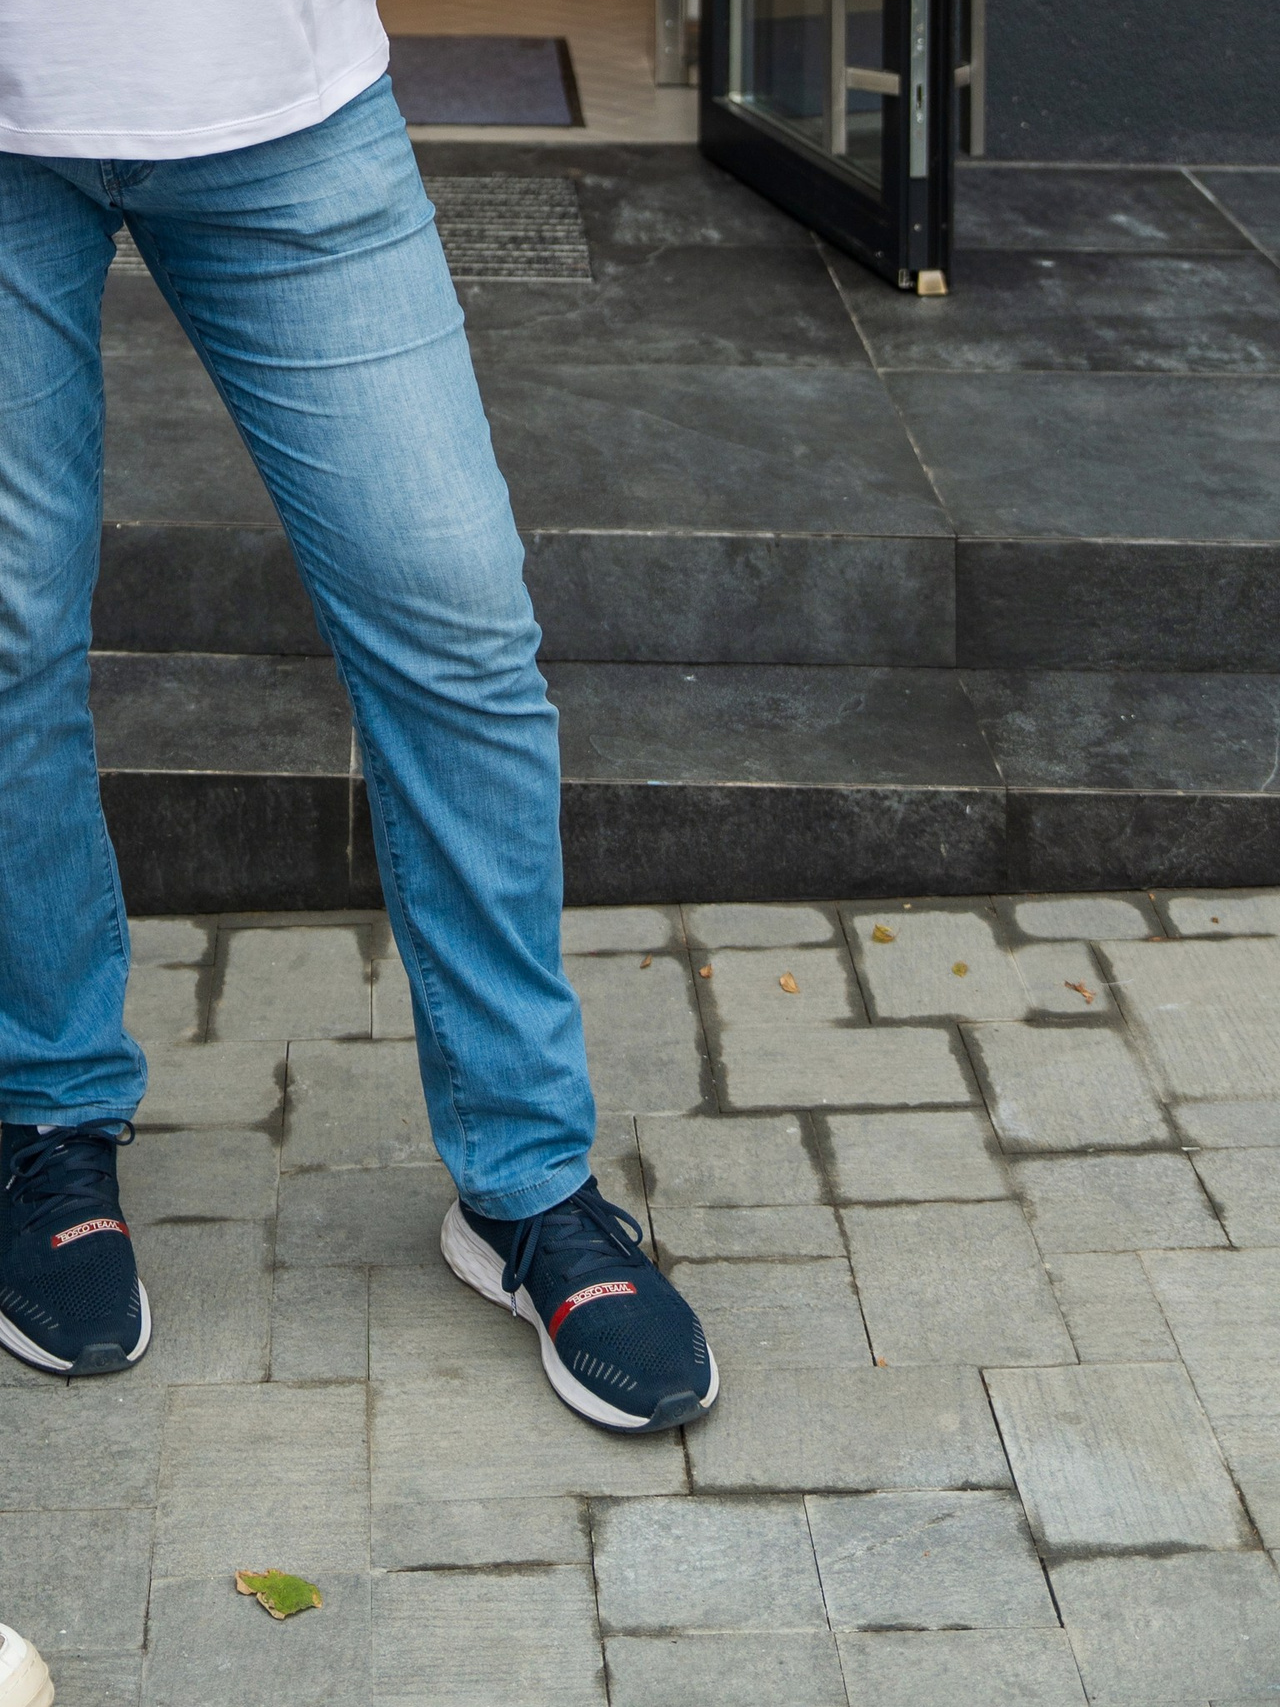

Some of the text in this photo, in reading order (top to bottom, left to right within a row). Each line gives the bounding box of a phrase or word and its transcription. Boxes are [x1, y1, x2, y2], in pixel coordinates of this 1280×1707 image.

[59, 1220, 120, 1242] BOSCO TEAM
[571, 1283, 631, 1305] BOSCO TEAM
